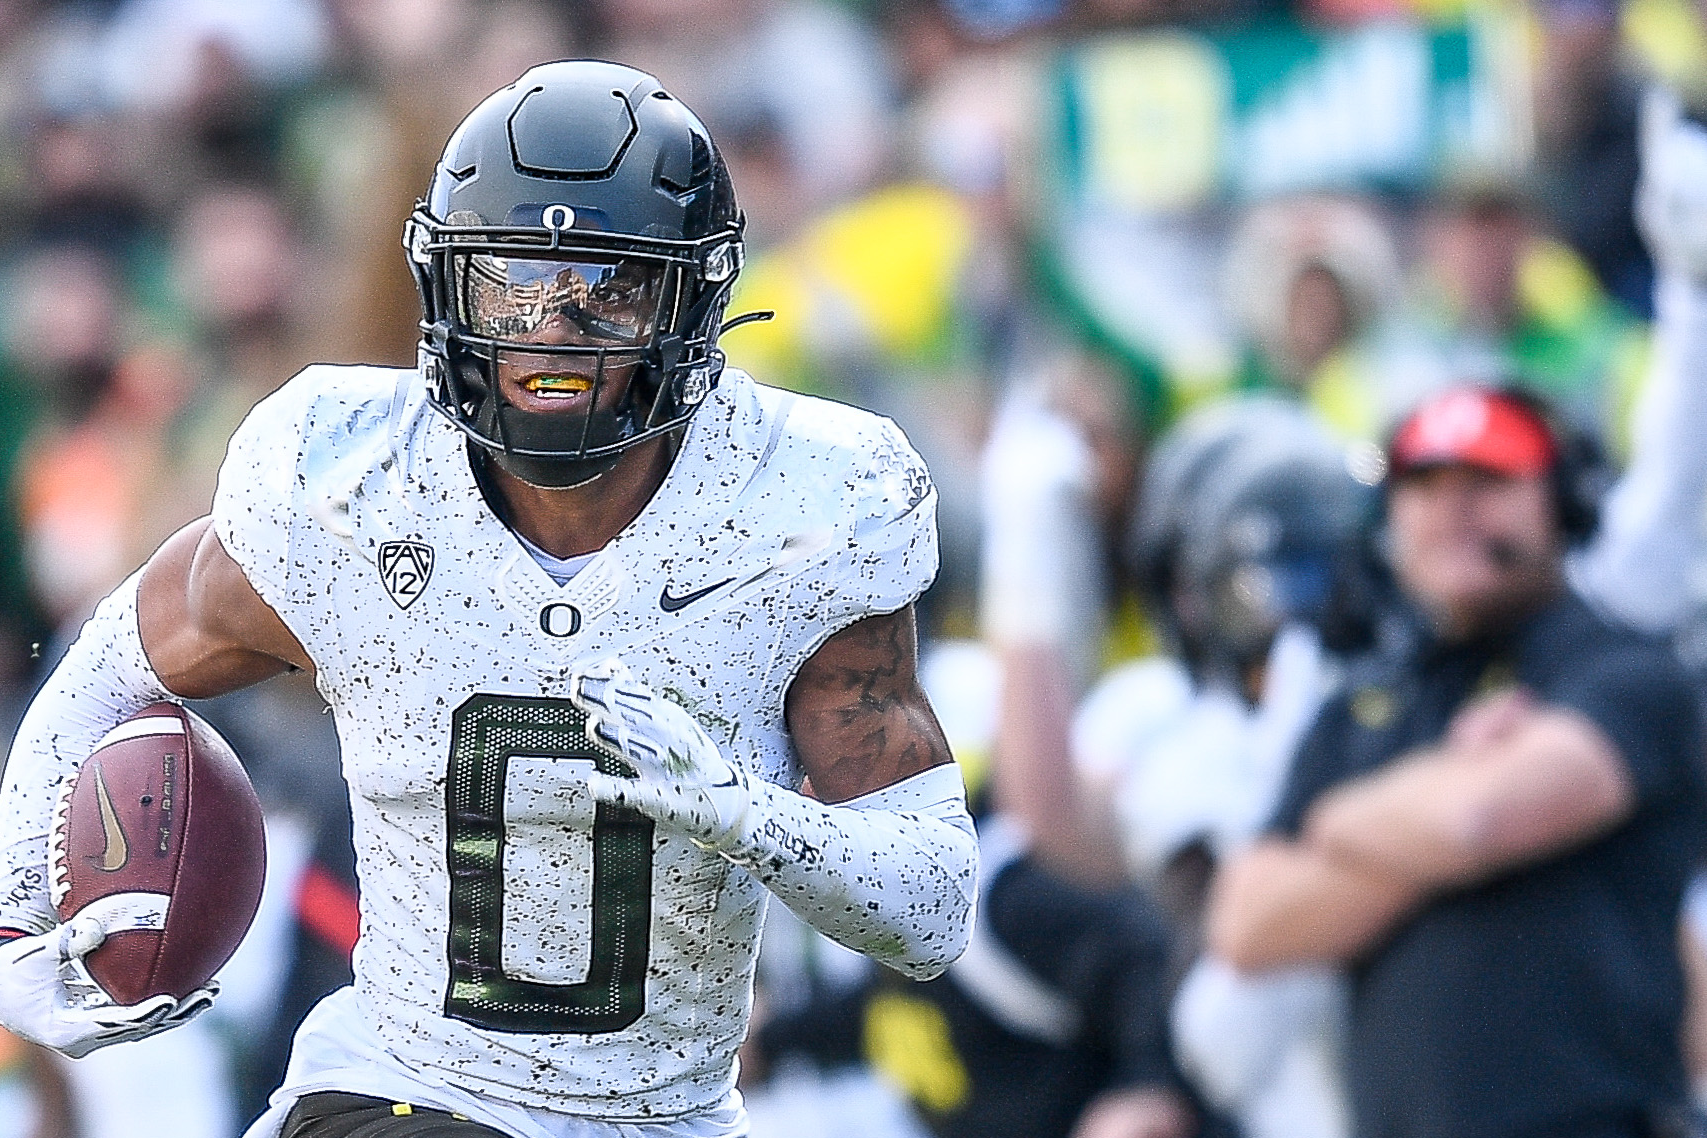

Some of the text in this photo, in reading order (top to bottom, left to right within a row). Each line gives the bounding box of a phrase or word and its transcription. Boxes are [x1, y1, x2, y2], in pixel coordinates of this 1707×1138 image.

[542, 204, 576, 231] O
[382, 545, 431, 583] PAC
[392, 571, 417, 595] 12
[540, 602, 581, 637] O
[445, 692, 655, 1034] 0
